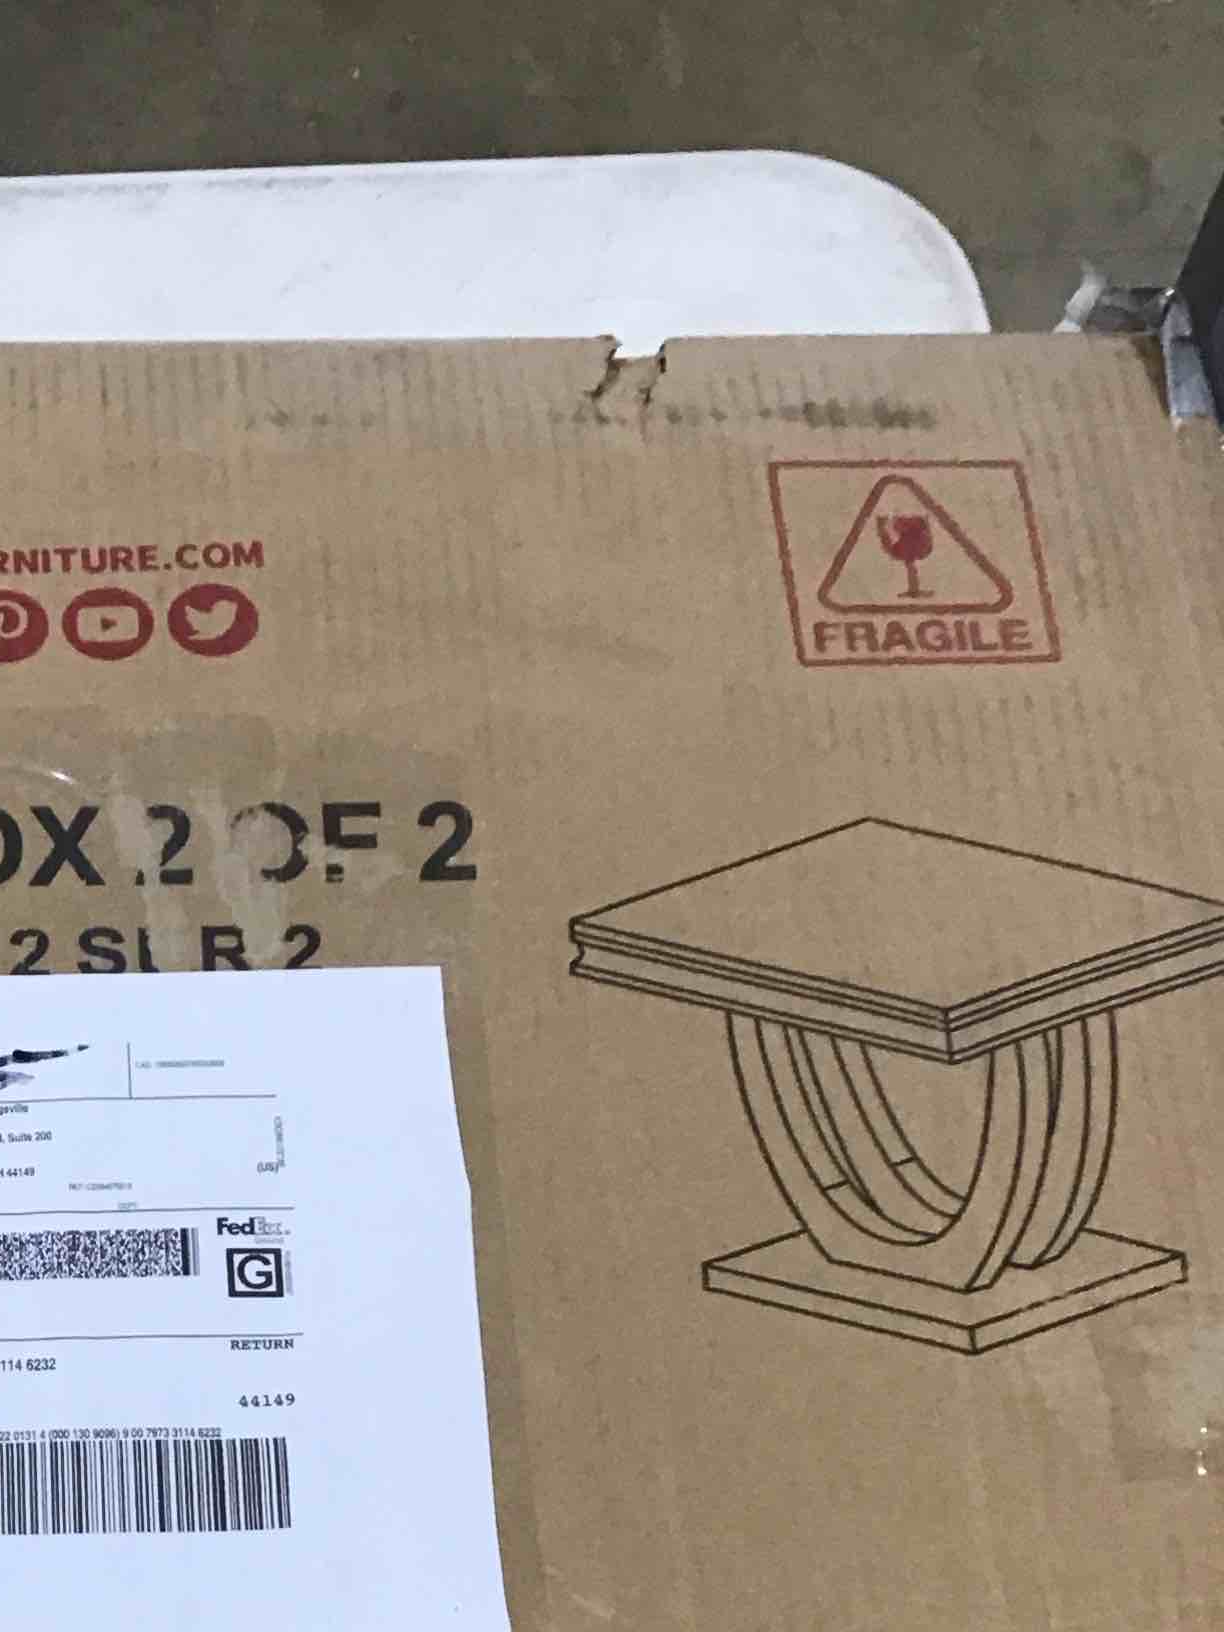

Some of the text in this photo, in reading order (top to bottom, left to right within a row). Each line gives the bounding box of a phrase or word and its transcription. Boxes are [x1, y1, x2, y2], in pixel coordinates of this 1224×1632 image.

[812, 619, 1035, 653] FRAGILE
[136, 804, 193, 886] 2
[417, 800, 477, 882] 2
[10, 927, 50, 975] 2
[283, 924, 324, 970] 2
[6, 1167, 35, 1177] 44149
[237, 1254, 273, 1290] G
[229, 1338, 295, 1350] RETURN
[26, 1358, 56, 1371] 6232
[239, 1393, 295, 1407] 44149
